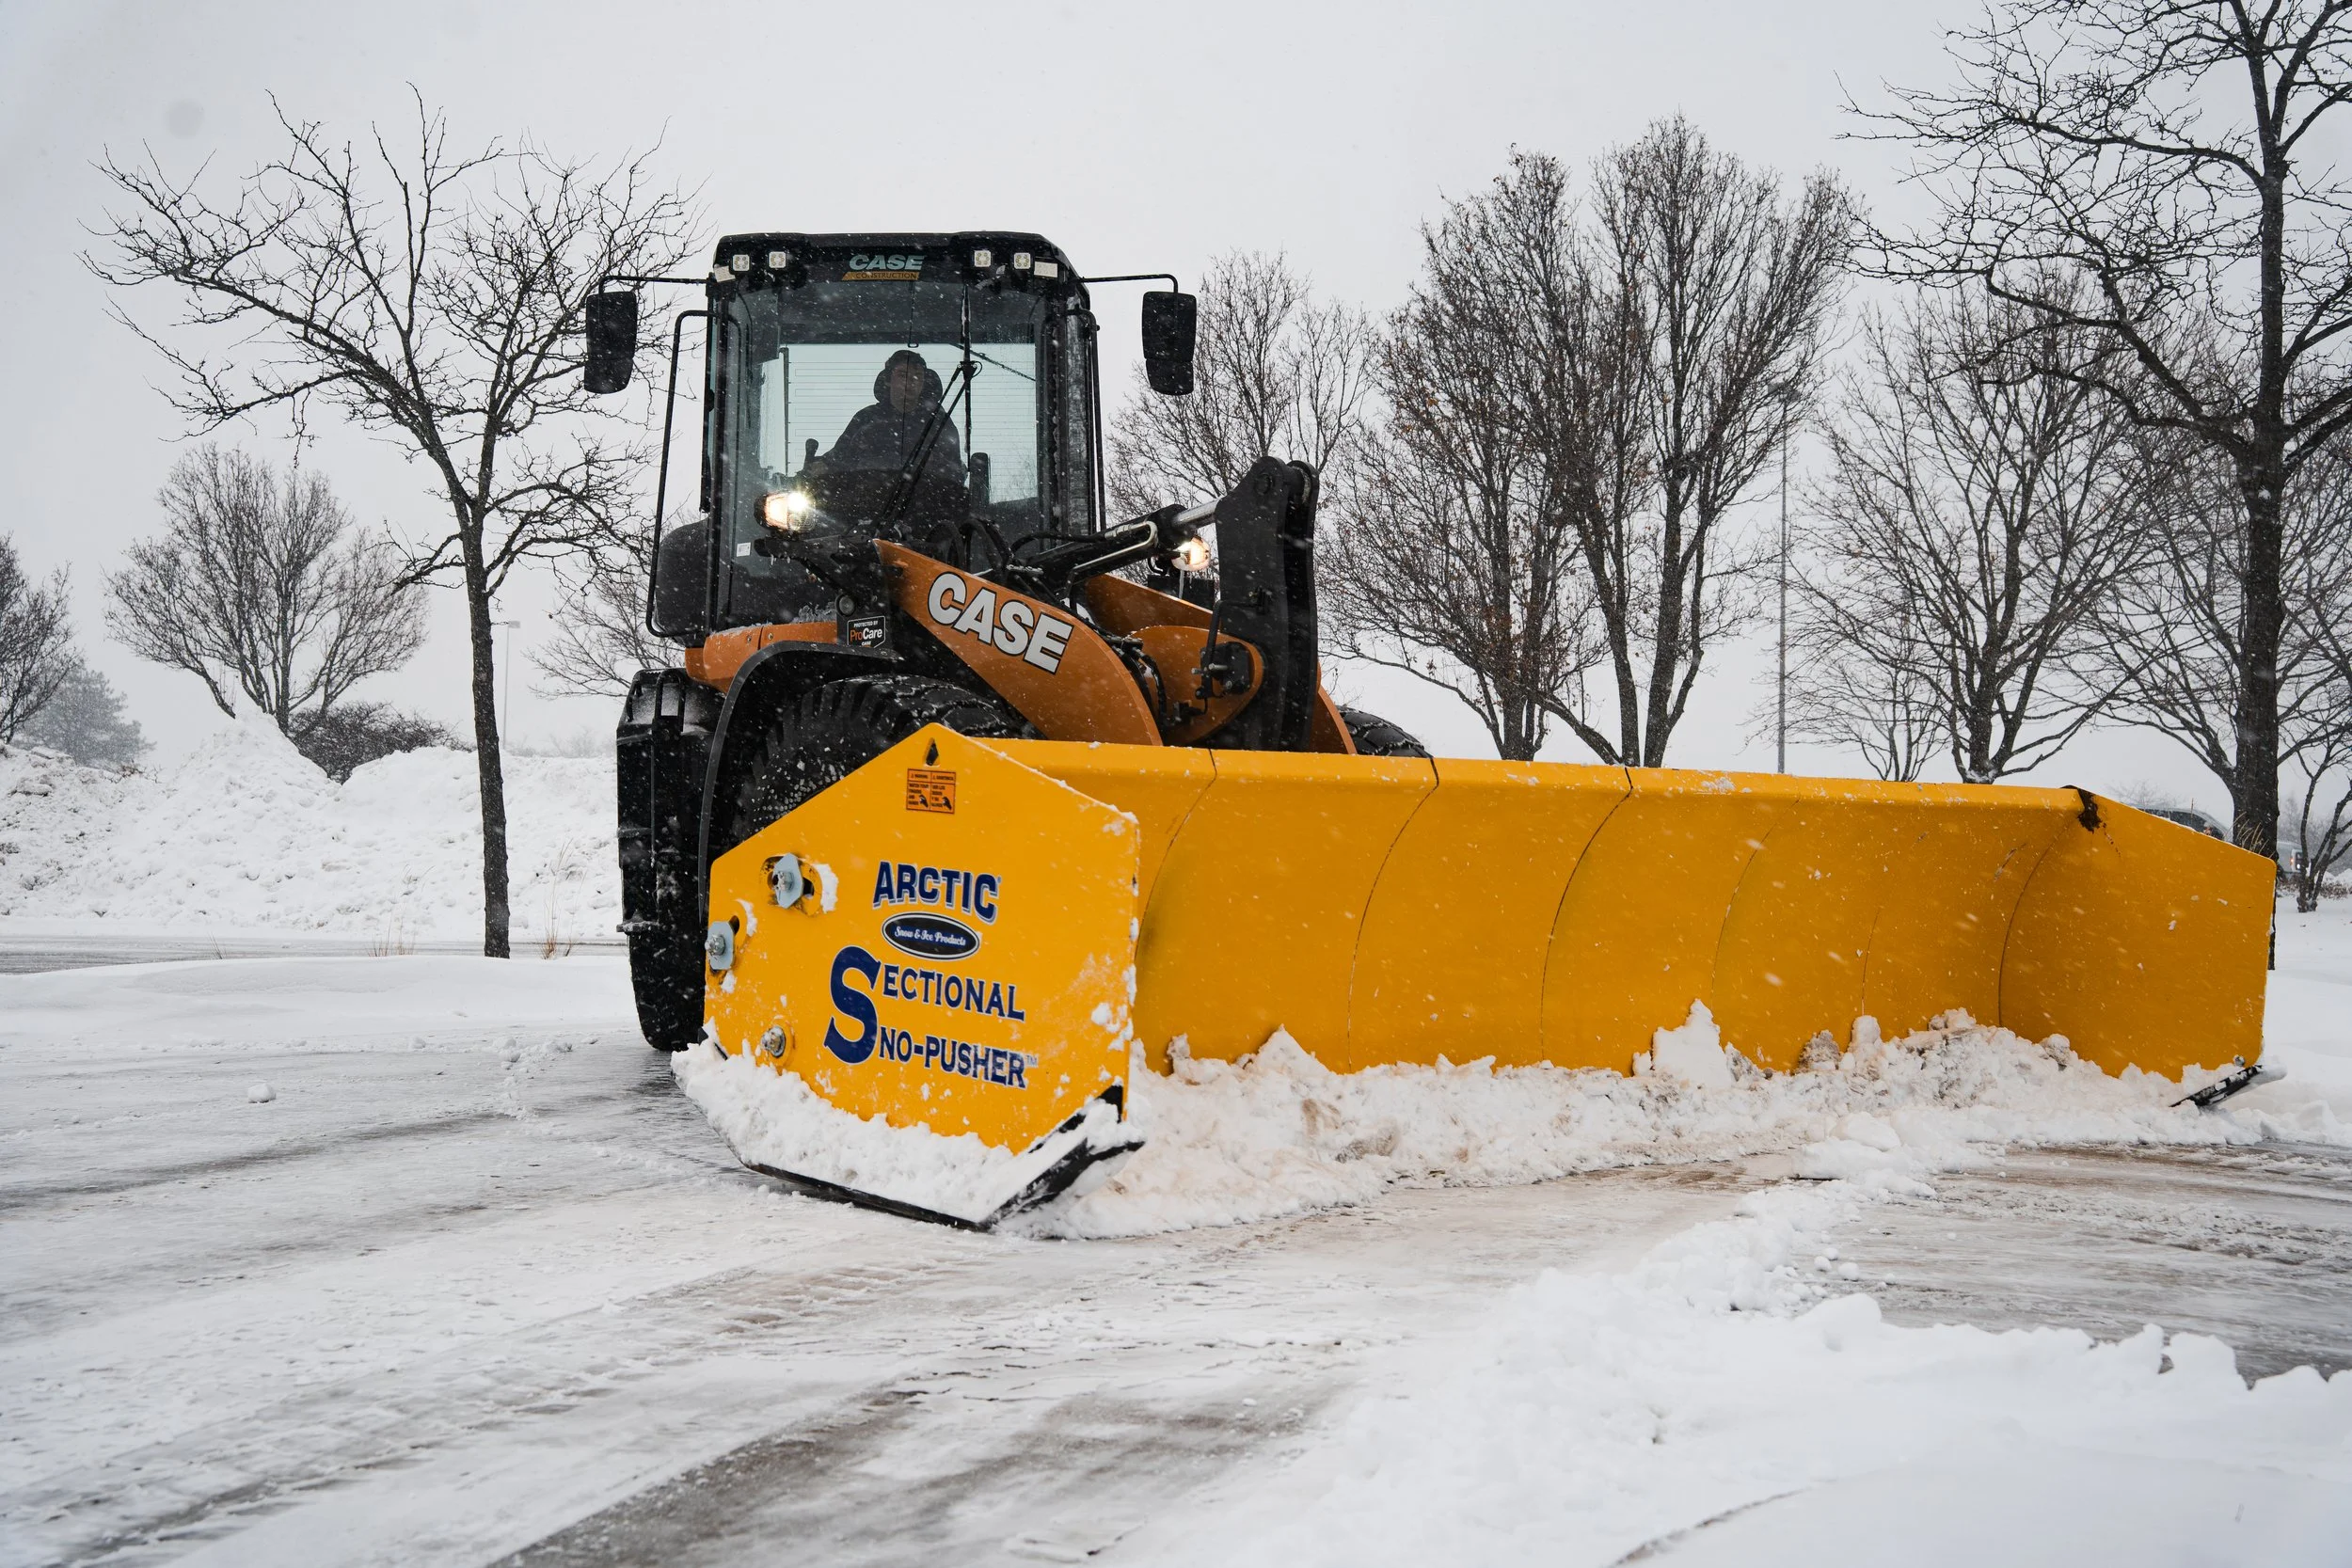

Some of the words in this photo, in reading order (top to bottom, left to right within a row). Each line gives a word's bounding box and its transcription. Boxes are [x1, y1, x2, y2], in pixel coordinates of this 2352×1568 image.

[849, 254, 925, 271] CASE
[928, 570, 1073, 675] CASE
[850, 627, 882, 641] ProCare
[872, 861, 1002, 925] ARCTIC
[894, 926, 913, 938] Snow
[914, 928, 921, 940] &
[921, 929, 934, 942] Ice
[934, 931, 967, 946] Products
